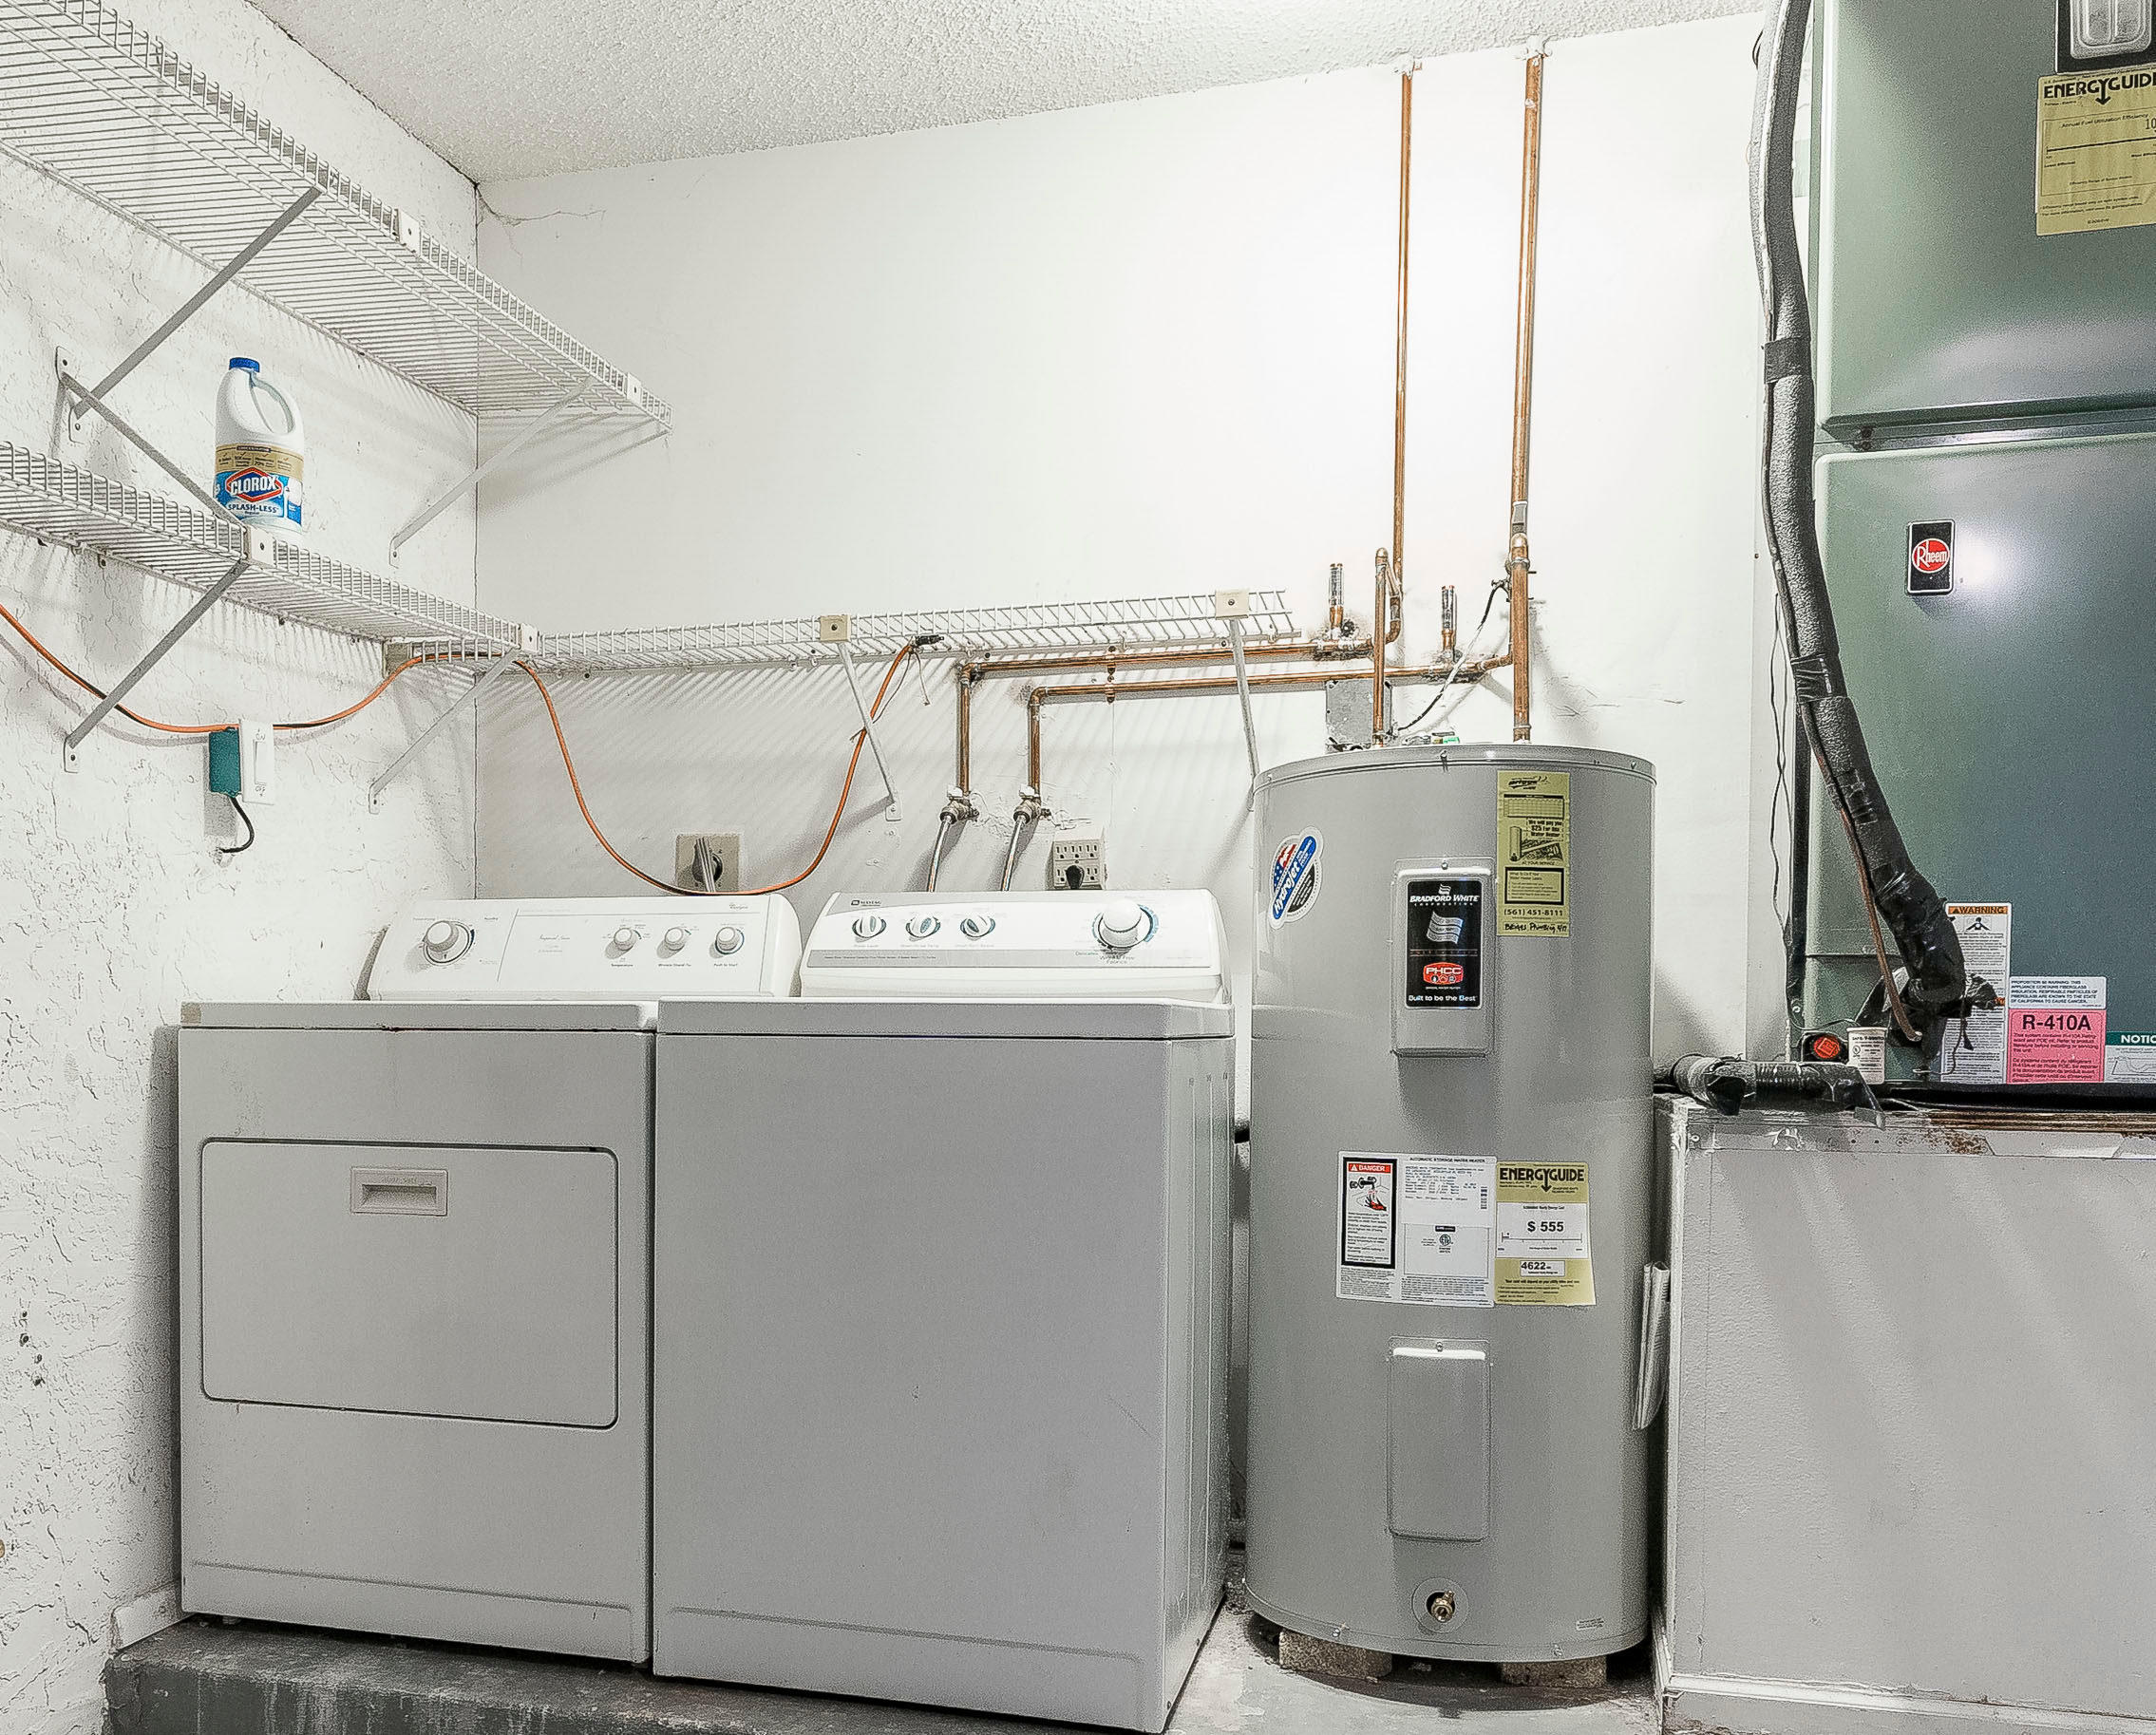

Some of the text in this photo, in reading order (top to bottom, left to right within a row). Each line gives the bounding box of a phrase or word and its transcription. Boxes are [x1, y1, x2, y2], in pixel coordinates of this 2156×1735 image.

[231, 476, 277, 496] CLOROX
[228, 503, 277, 514] SPLASH-LESS
[1917, 540, 1948, 568] Rheem
[1426, 967, 1462, 975] PHCC
[2022, 1014, 2091, 1030] R-410A
[2121, 1034, 2156, 1044] NOTIC
[1500, 1167, 1585, 1181] ENERGYGUIDE
[1527, 1220, 1564, 1232] $ 555
